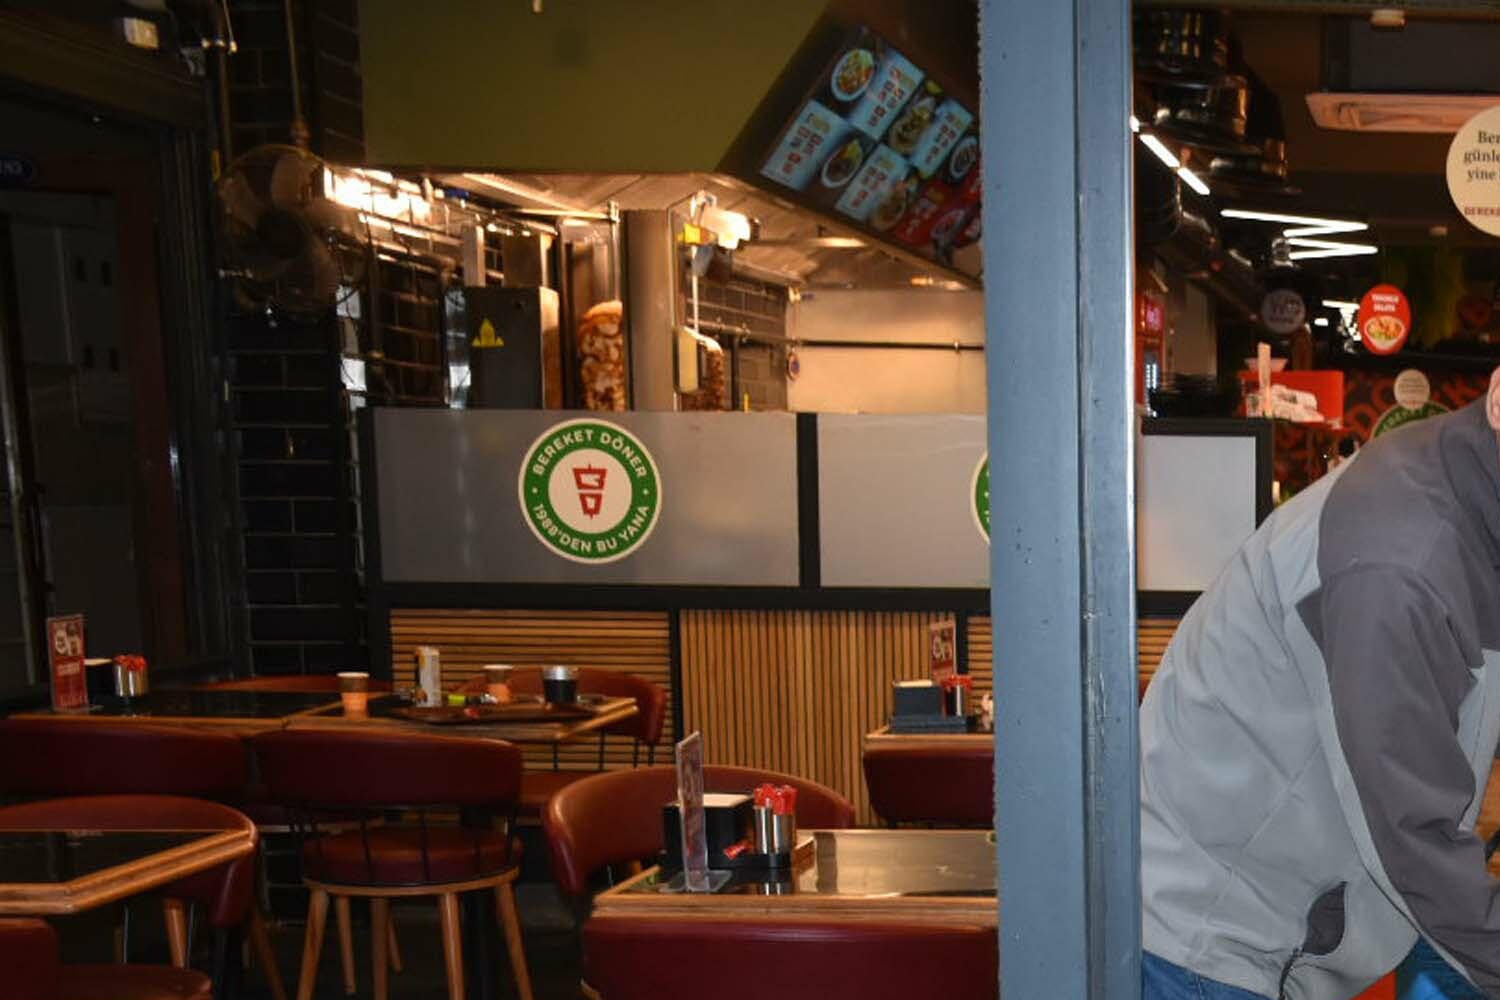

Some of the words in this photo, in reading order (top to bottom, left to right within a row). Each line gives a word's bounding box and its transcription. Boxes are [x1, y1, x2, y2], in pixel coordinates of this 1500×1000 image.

[1467, 169, 1496, 183] yine
[532, 429, 594, 476] BEREKET
[600, 431, 648, 478] DÖNER
[596, 537, 618, 553] BU
[618, 504, 650, 542] YANA
